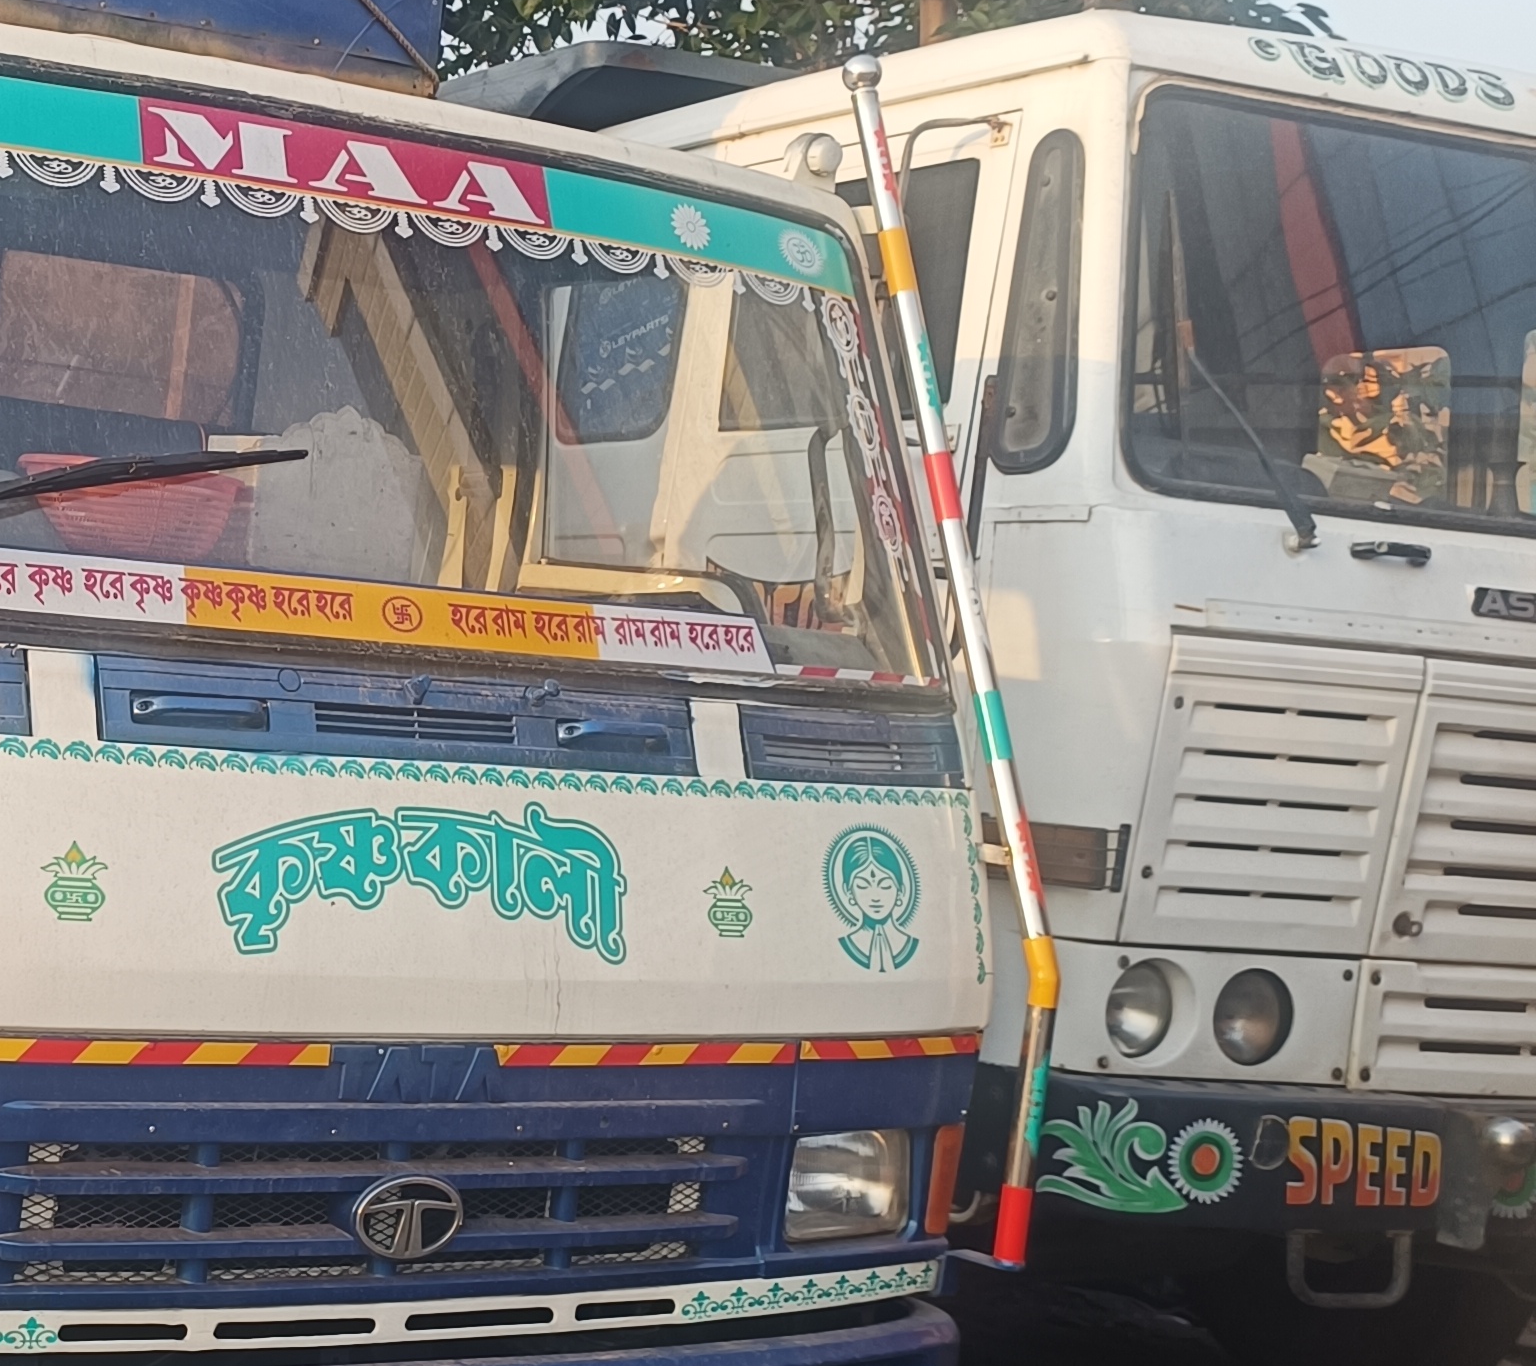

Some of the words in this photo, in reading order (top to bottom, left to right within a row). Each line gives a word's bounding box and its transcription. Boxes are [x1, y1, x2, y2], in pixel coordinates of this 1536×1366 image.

[1278, 38, 1516, 110] GOODS
[148, 107, 546, 224] MAA
[611, 314, 669, 349] LEYPARTS
[330, 1044, 505, 1102] TATA
[1286, 1116, 1442, 1206] SPEED
